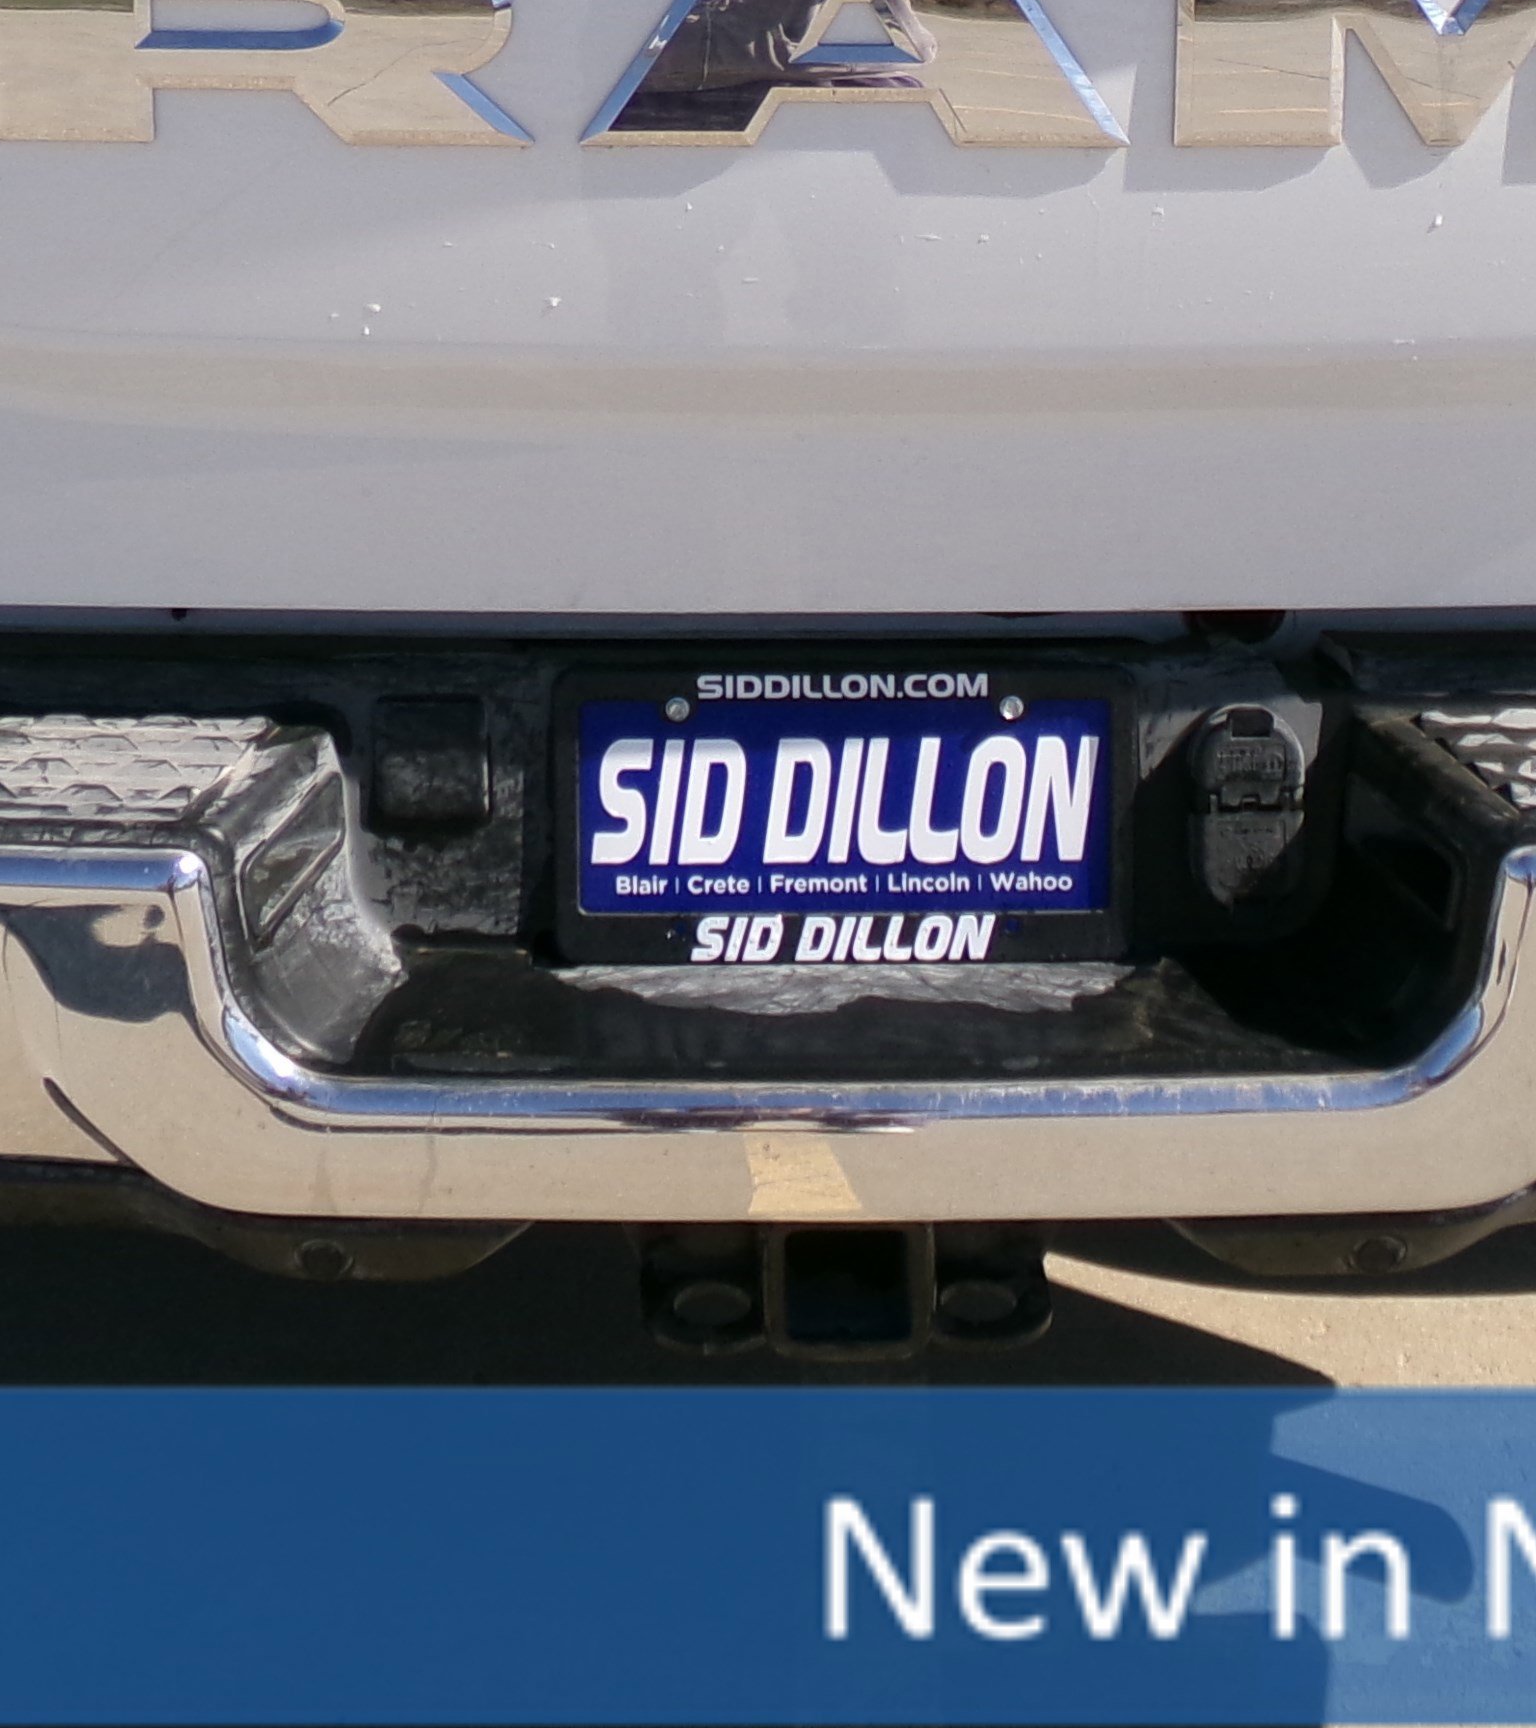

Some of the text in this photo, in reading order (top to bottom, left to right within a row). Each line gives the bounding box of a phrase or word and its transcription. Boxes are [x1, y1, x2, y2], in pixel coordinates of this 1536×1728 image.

[696, 673, 989, 700] SIDDILLON.COM
[591, 735, 1100, 865] SID DILLON
[616, 871, 1073, 896] Blair Crete Fremont Lincoln Wahoo
[690, 913, 997, 962] SID DILLON
